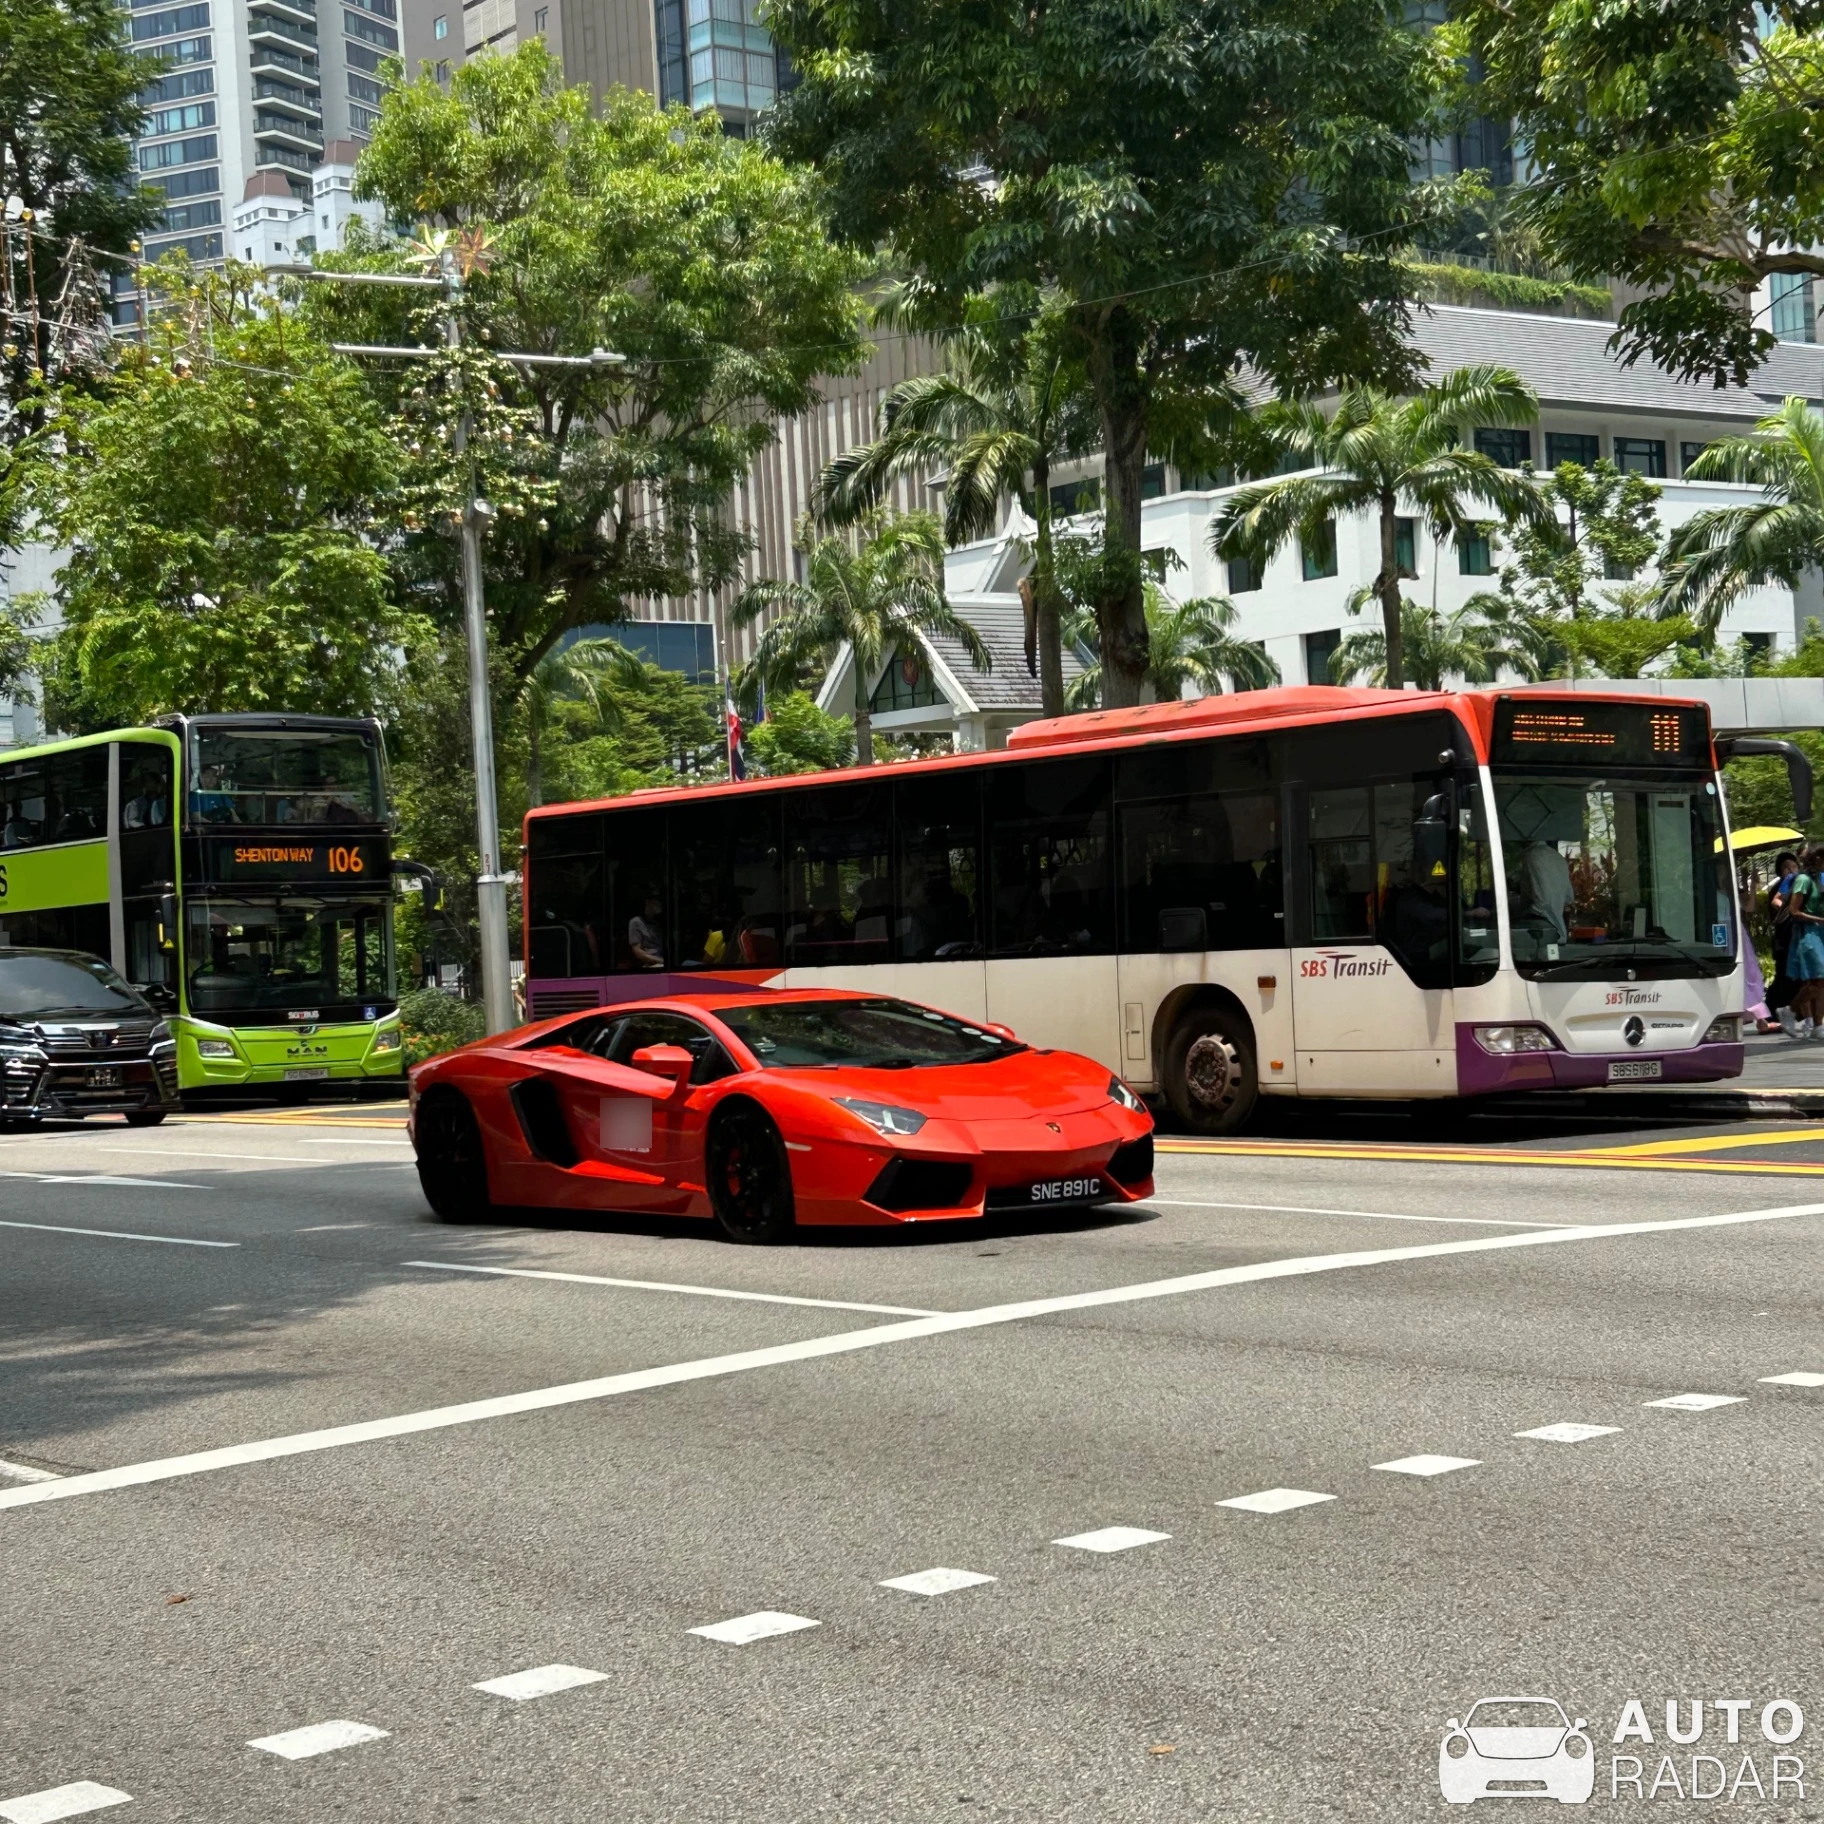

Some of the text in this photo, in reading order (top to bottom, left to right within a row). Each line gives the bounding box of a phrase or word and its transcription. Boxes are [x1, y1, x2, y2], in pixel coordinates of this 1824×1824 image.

[328, 846, 363, 872] 106
[1300, 954, 1394, 980] SBS Transit
[1605, 988, 1662, 1005] SBS Transit
